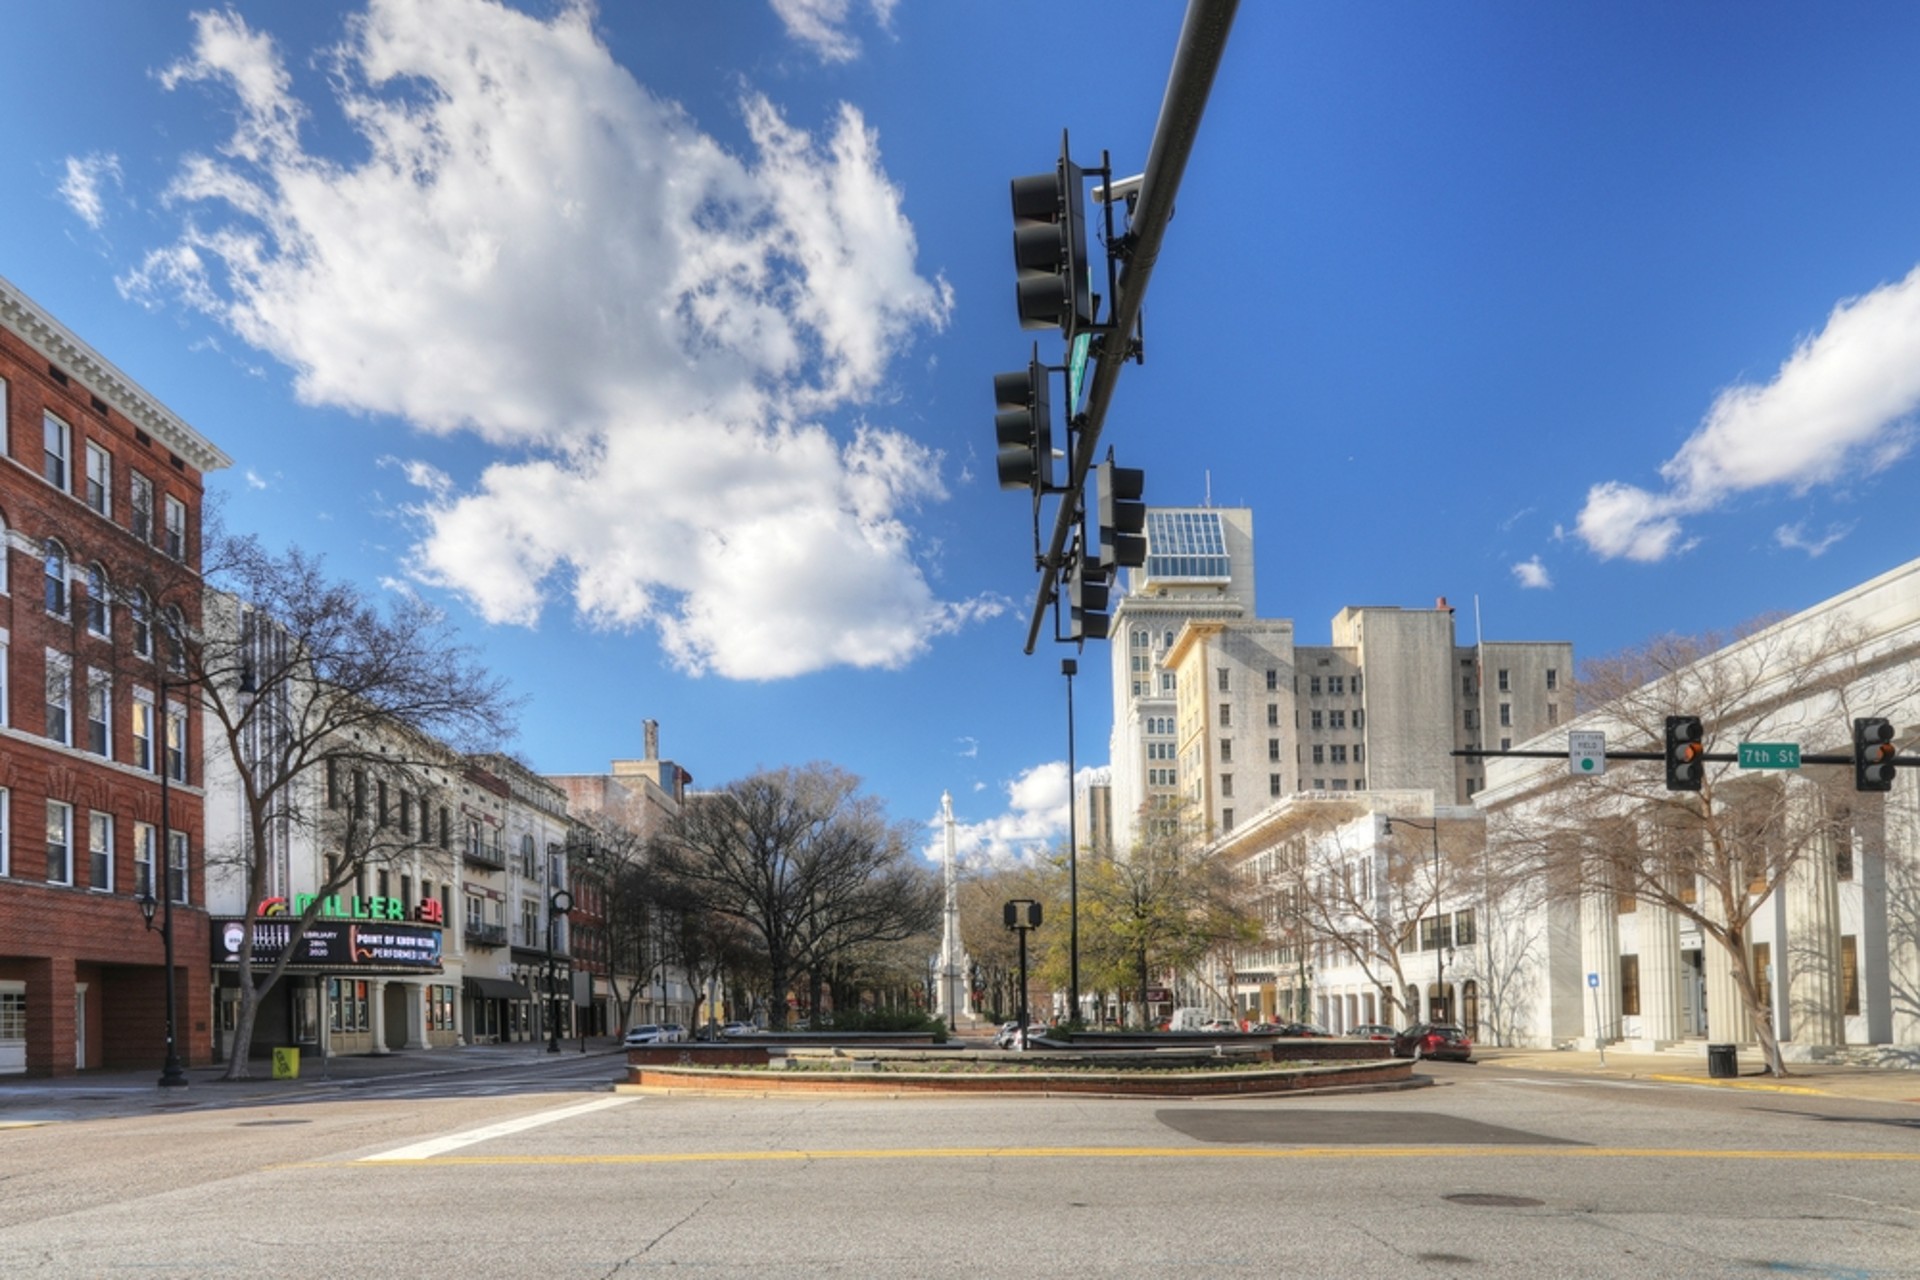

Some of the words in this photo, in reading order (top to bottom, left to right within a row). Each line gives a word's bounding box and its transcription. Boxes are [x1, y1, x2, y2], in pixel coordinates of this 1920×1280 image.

[1745, 749, 1769, 763] 7th
[1779, 749, 1794, 763] St
[295, 893, 404, 920] MILLER
[385, 935, 395, 945] OF
